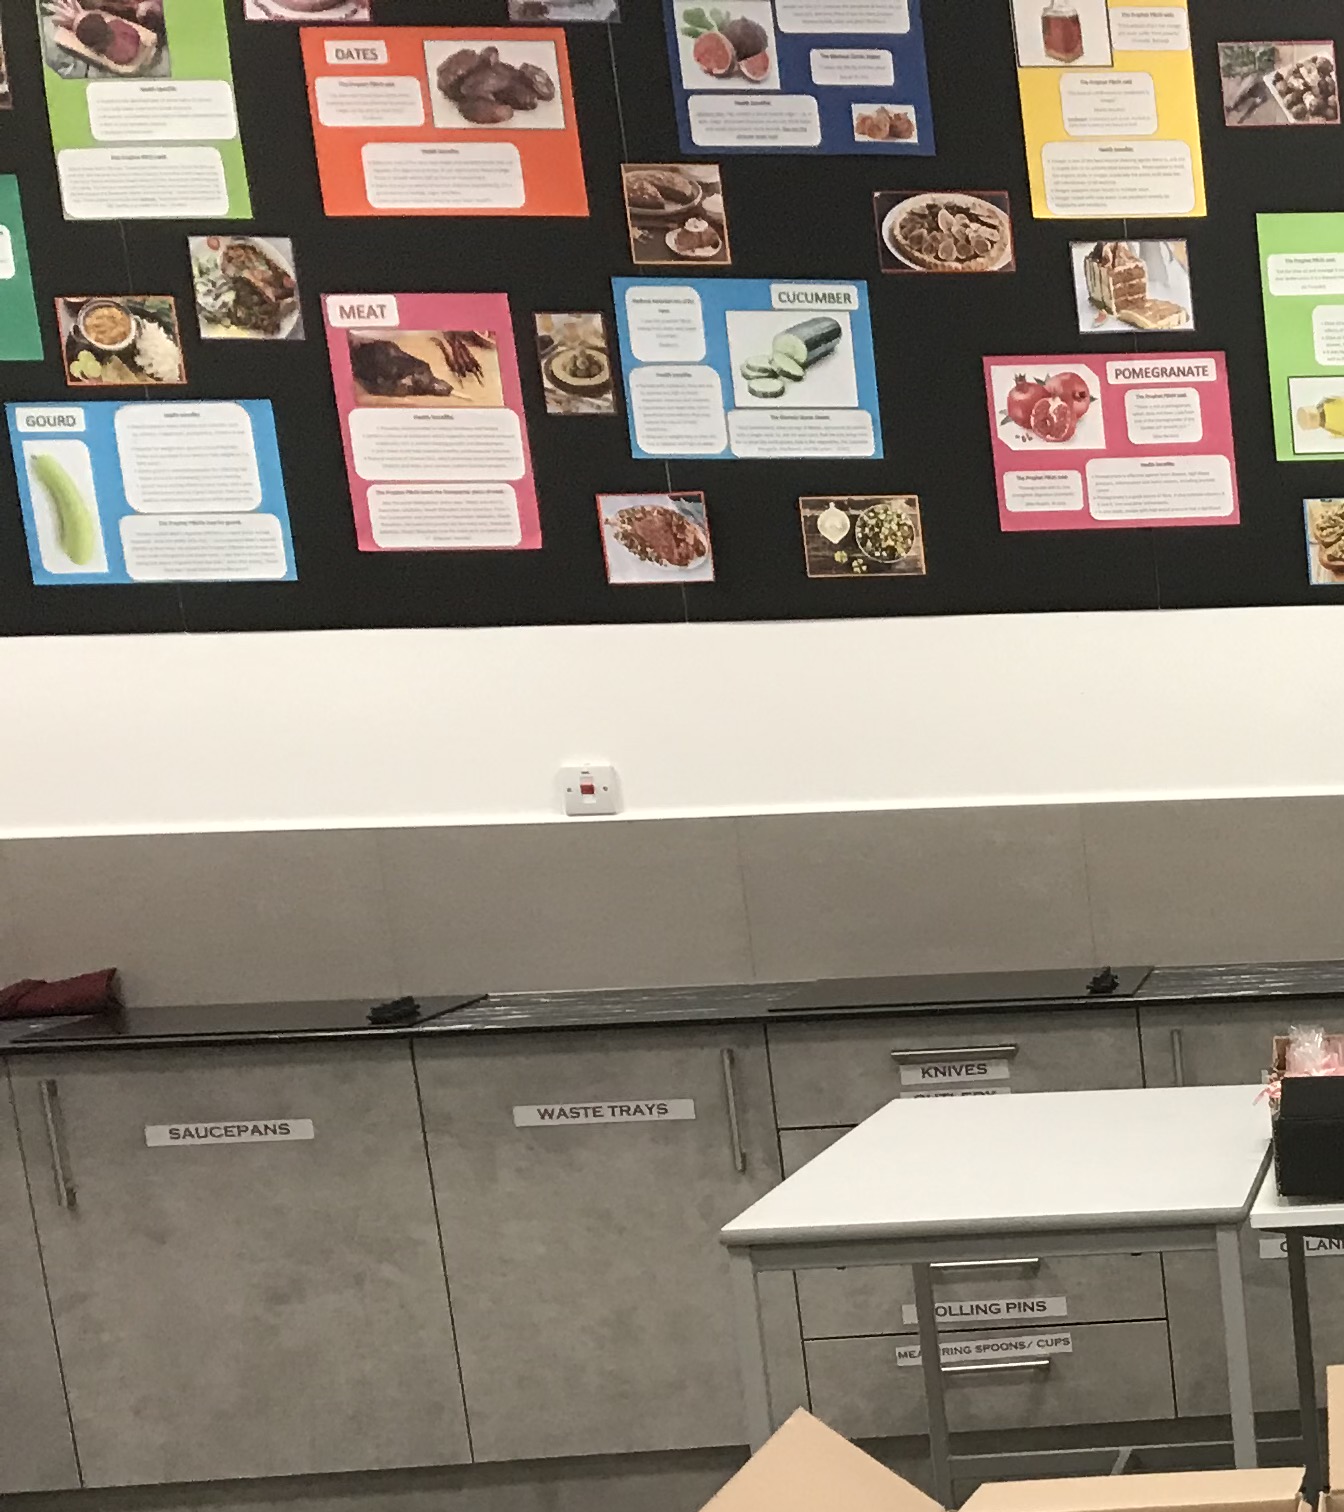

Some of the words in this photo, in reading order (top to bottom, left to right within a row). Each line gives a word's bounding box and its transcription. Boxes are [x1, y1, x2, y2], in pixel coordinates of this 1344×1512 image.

[335, 48, 378, 61] DATES
[778, 292, 852, 305] CUCUMBER
[339, 304, 386, 320] MEAT
[1115, 365, 1208, 380] POMEGRANATE
[26, 415, 76, 427] GOURD
[921, 1063, 987, 1078] KNIVES
[537, 1106, 604, 1120] WASTE
[607, 1103, 668, 1117] TRAYS
[169, 1123, 290, 1140] SAUCEPANS
[935, 1303, 1000, 1317] OLLING
[1006, 1301, 1047, 1313] PINS
[1037, 1338, 1070, 1348] CUPS
